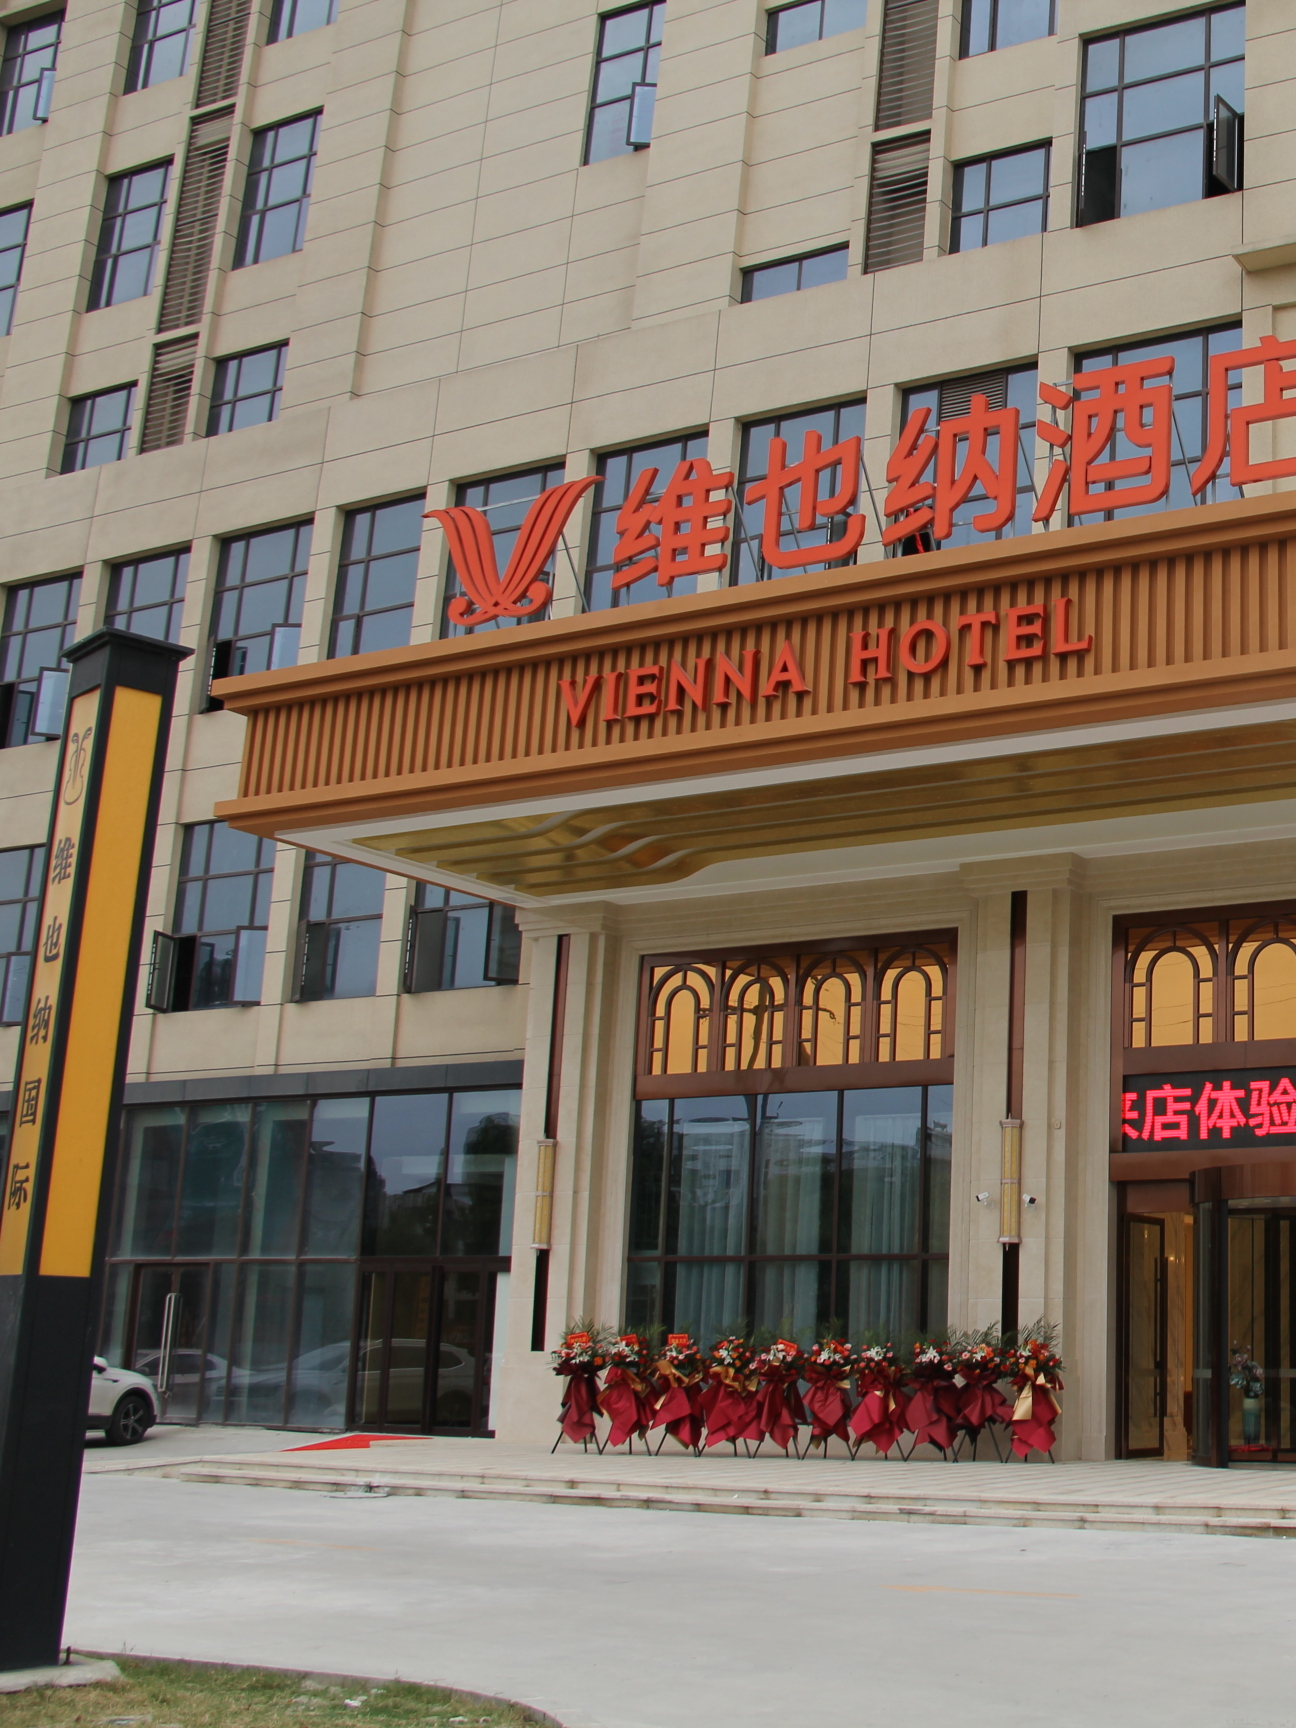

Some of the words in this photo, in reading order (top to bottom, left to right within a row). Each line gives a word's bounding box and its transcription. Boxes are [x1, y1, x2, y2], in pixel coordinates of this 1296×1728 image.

[558, 641, 811, 730] VIENNA
[848, 597, 1093, 685] HOTEL
[8, 836, 76, 1212] 维也纳国际
